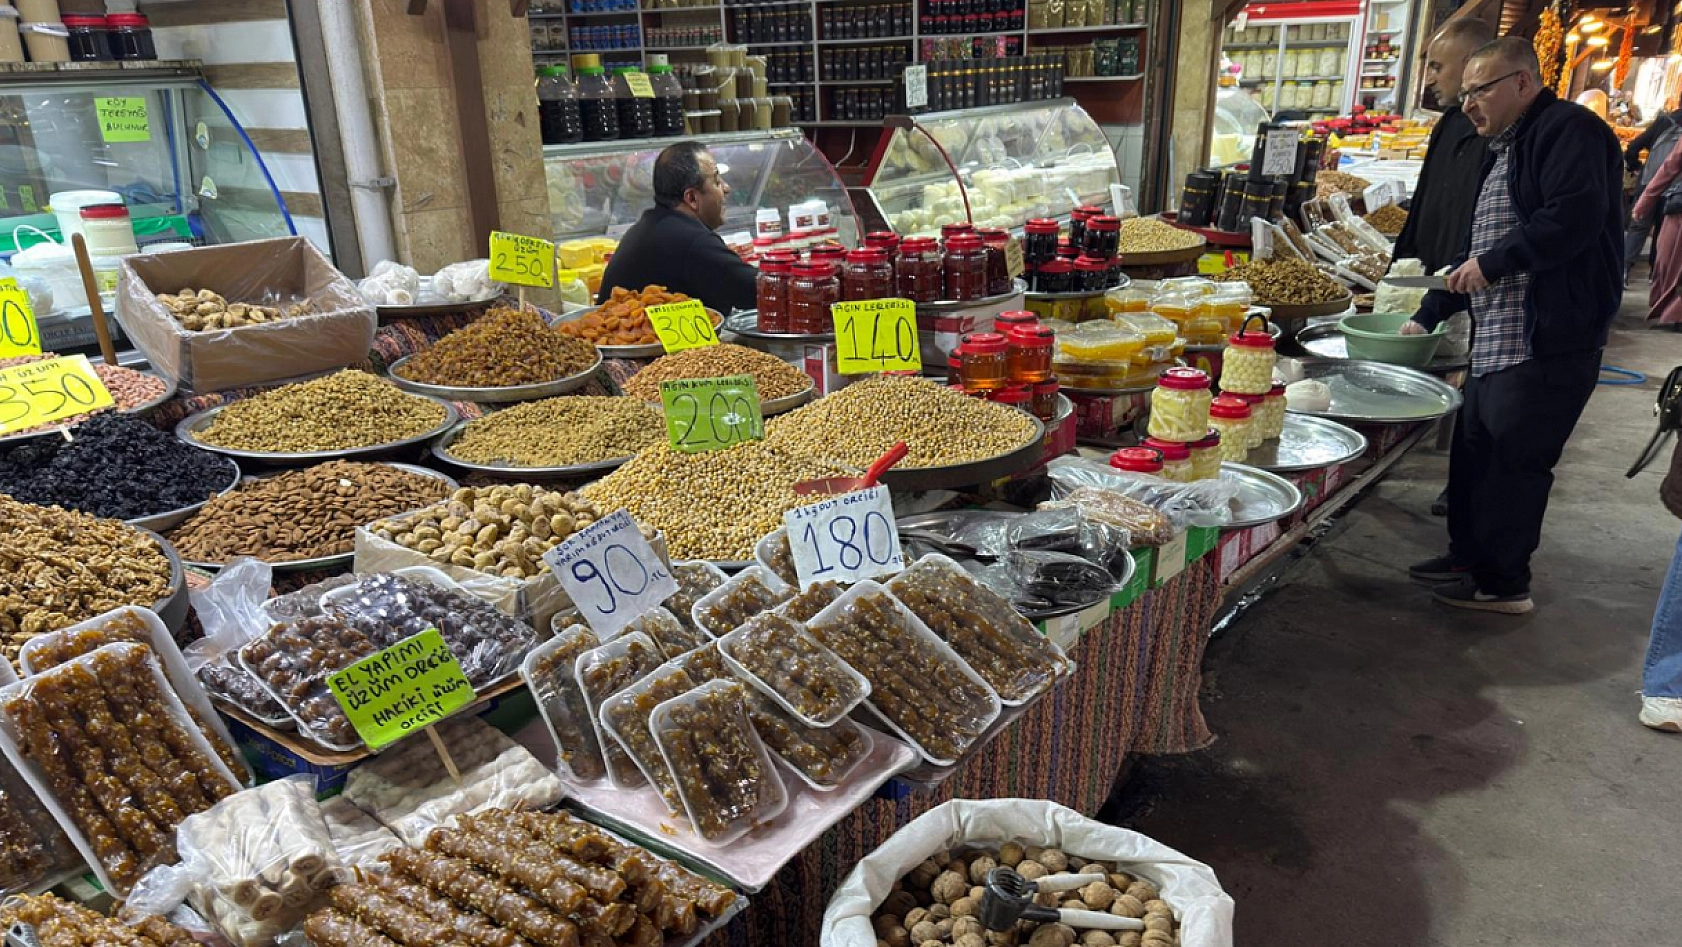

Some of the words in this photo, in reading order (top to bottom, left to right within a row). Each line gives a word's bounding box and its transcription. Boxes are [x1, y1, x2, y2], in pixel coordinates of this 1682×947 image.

[495, 252, 544, 277] 250
[658, 315, 712, 345] 300
[843, 312, 914, 367] 140
[672, 392, 754, 445] 200
[803, 511, 892, 575] 180
[571, 543, 649, 614] 90
[334, 672, 359, 692] EL
[358, 640, 424, 679] YAPIMI
[345, 677, 403, 711] ÜZÜM
[372, 686, 427, 727] HAKİKİ
